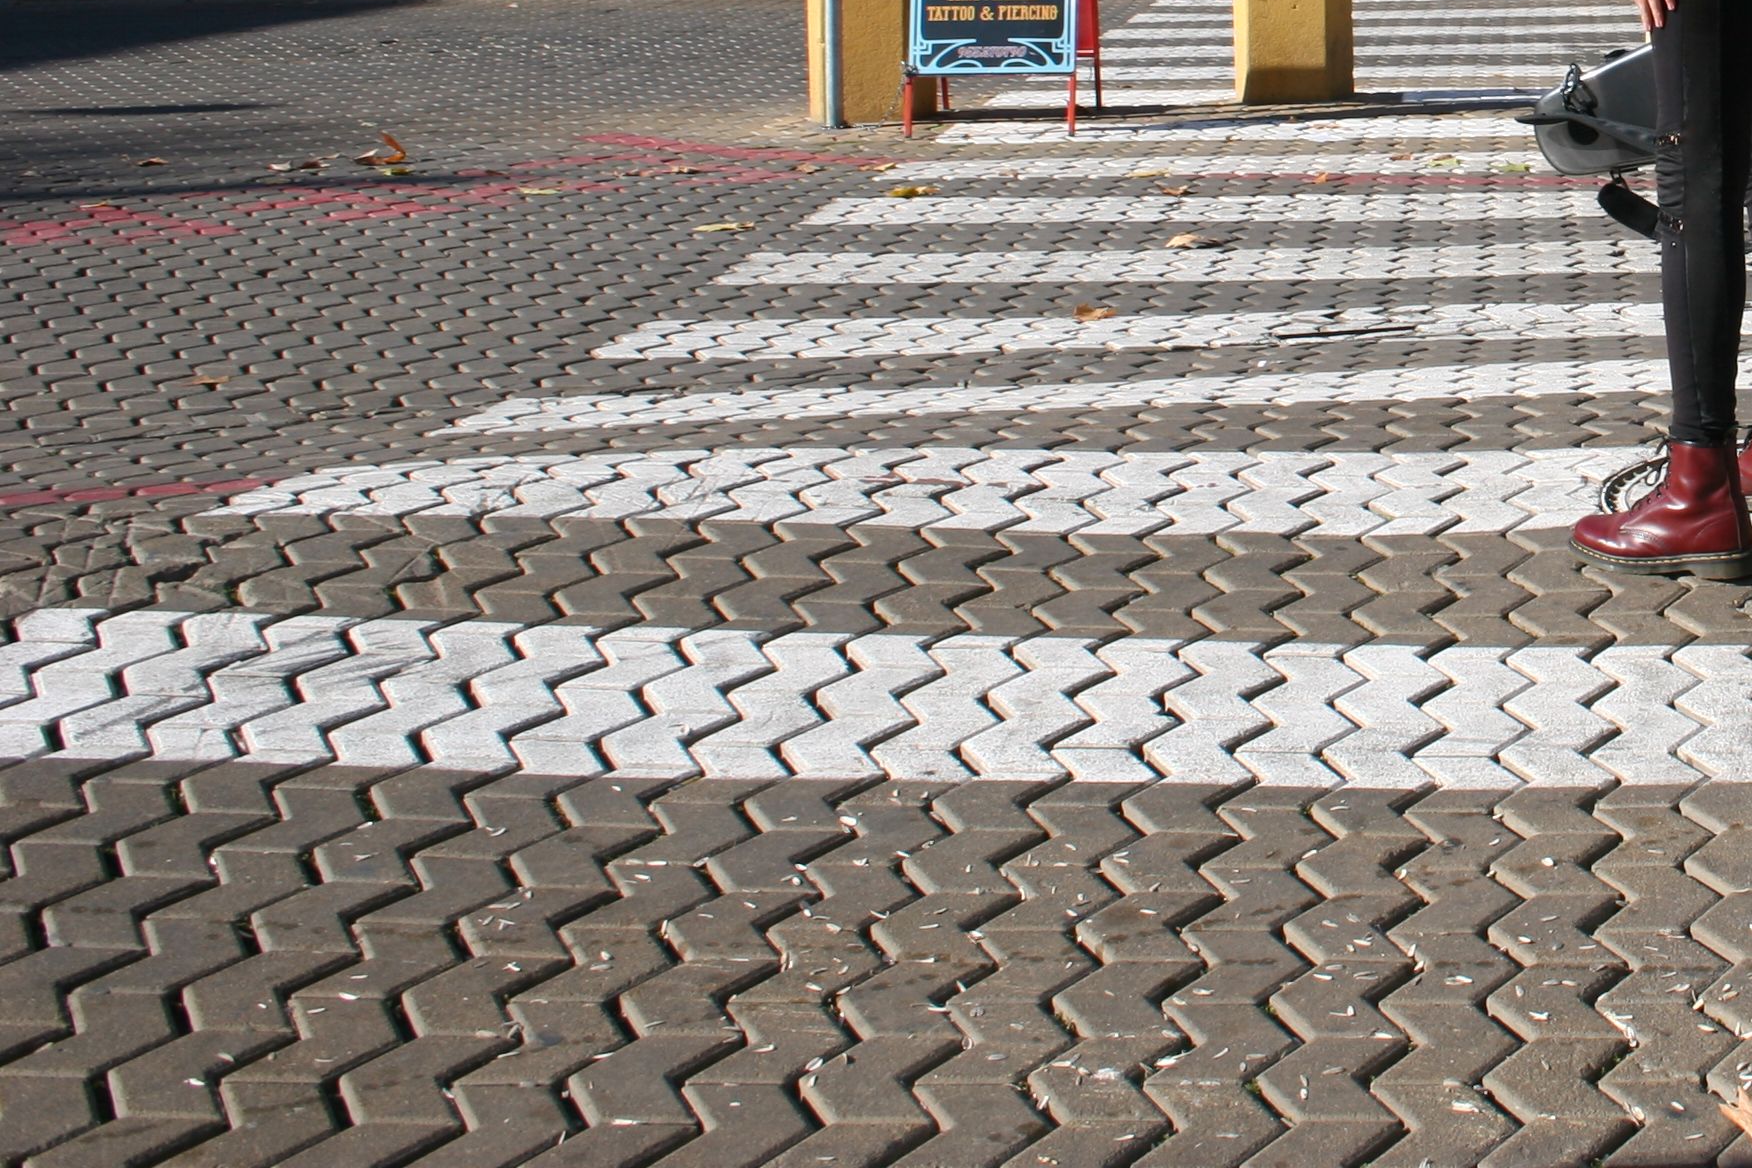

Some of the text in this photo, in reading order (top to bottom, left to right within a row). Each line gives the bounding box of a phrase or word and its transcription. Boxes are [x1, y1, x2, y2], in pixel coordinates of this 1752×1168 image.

[926, 5, 1058, 22] TATTOO & PIERCING
